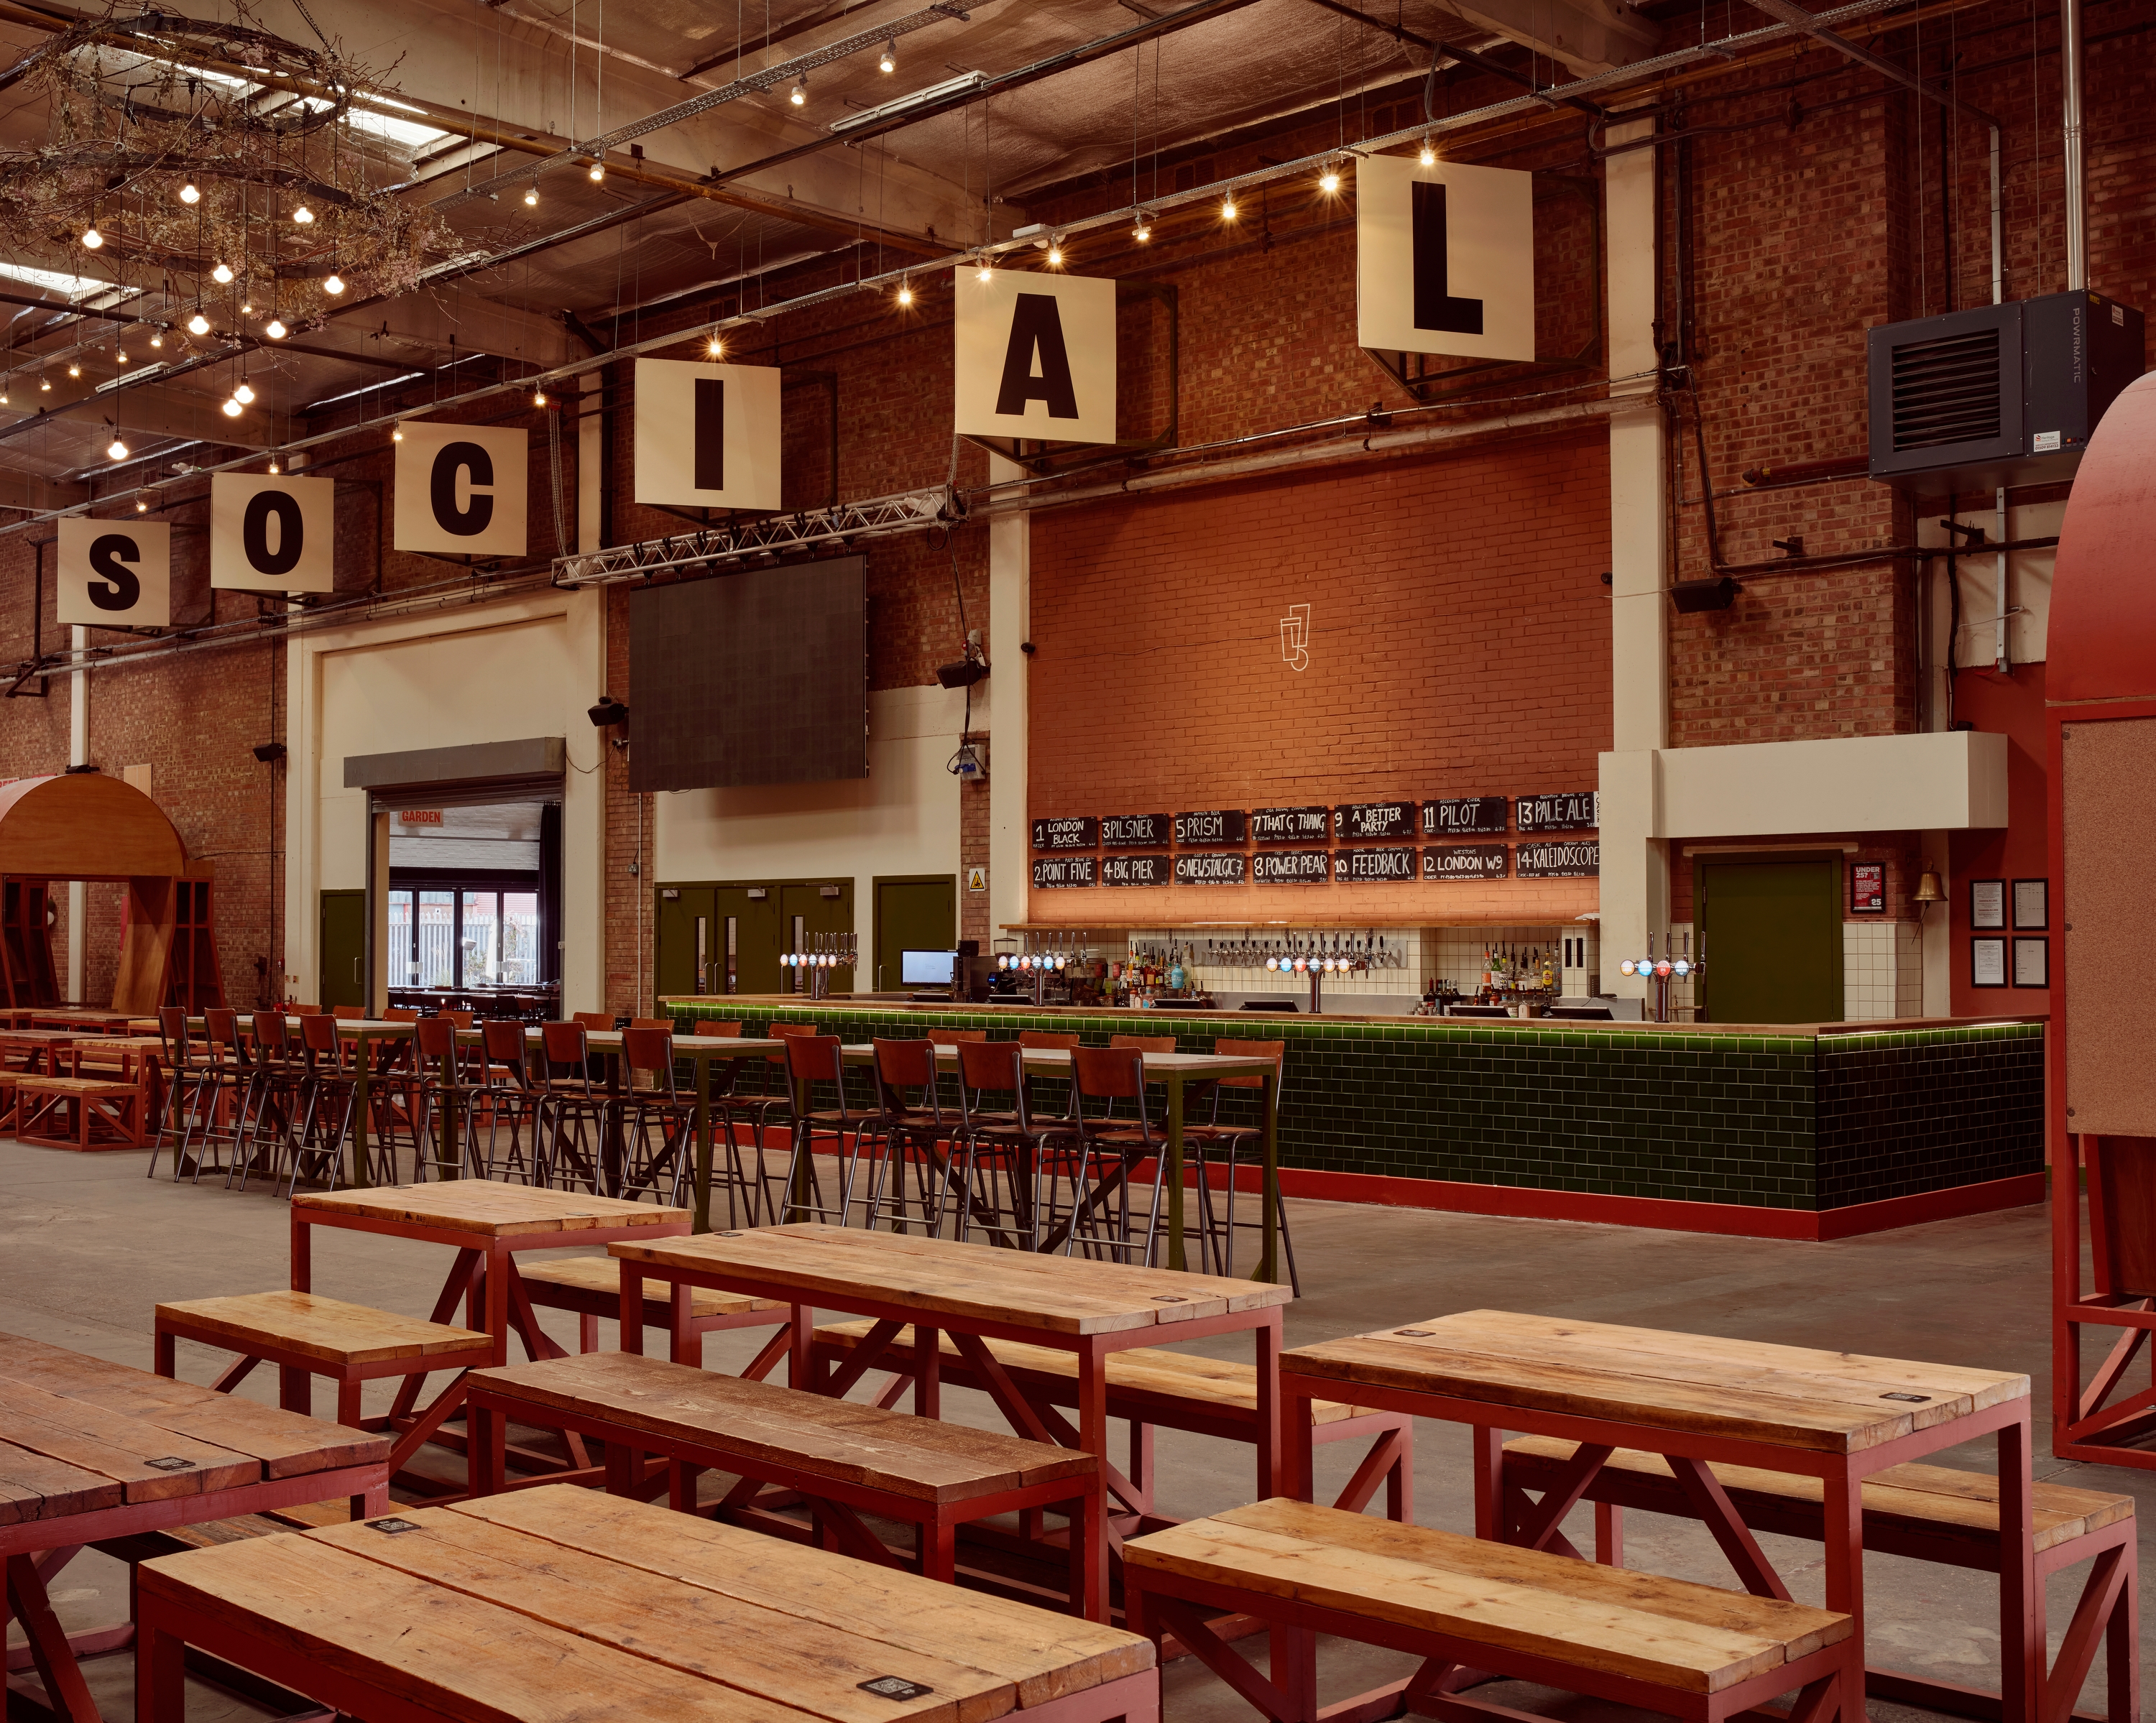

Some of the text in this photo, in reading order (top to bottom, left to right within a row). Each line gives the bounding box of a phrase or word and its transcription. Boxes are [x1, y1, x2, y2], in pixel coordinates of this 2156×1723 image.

[402, 810, 440, 823] GARDEN
[1335, 807, 1401, 827] 9 A BETTER
[1424, 804, 1480, 828] 11 PILOT
[1519, 802, 1532, 823] 13
[1536, 799, 1563, 823] PALE
[1566, 798, 1590, 821] ALE
[1036, 821, 1084, 841] 1 LONDON
[1102, 819, 1153, 839] 3 PILSNER
[1176, 816, 1222, 838] 5 PRISM
[1254, 814, 1326, 833] 7 THAT G THANG
[1361, 821, 1388, 832] PARTY
[1054, 833, 1079, 844] BLACK
[1255, 855, 1327, 876] 8 POWER PEAR
[1353, 853, 1410, 875] FEEDBACK
[1424, 856, 1503, 872] 12 LONDON W9
[1516, 846, 1599, 869] 14 KALEIDOSCOPE
[1043, 864, 1066, 882] POINT
[1071, 862, 1092, 880] FIVE
[1104, 860, 1153, 879] 4 BIG PIER
[1176, 859, 1243, 877] 6 NEWSTALGIC 7
